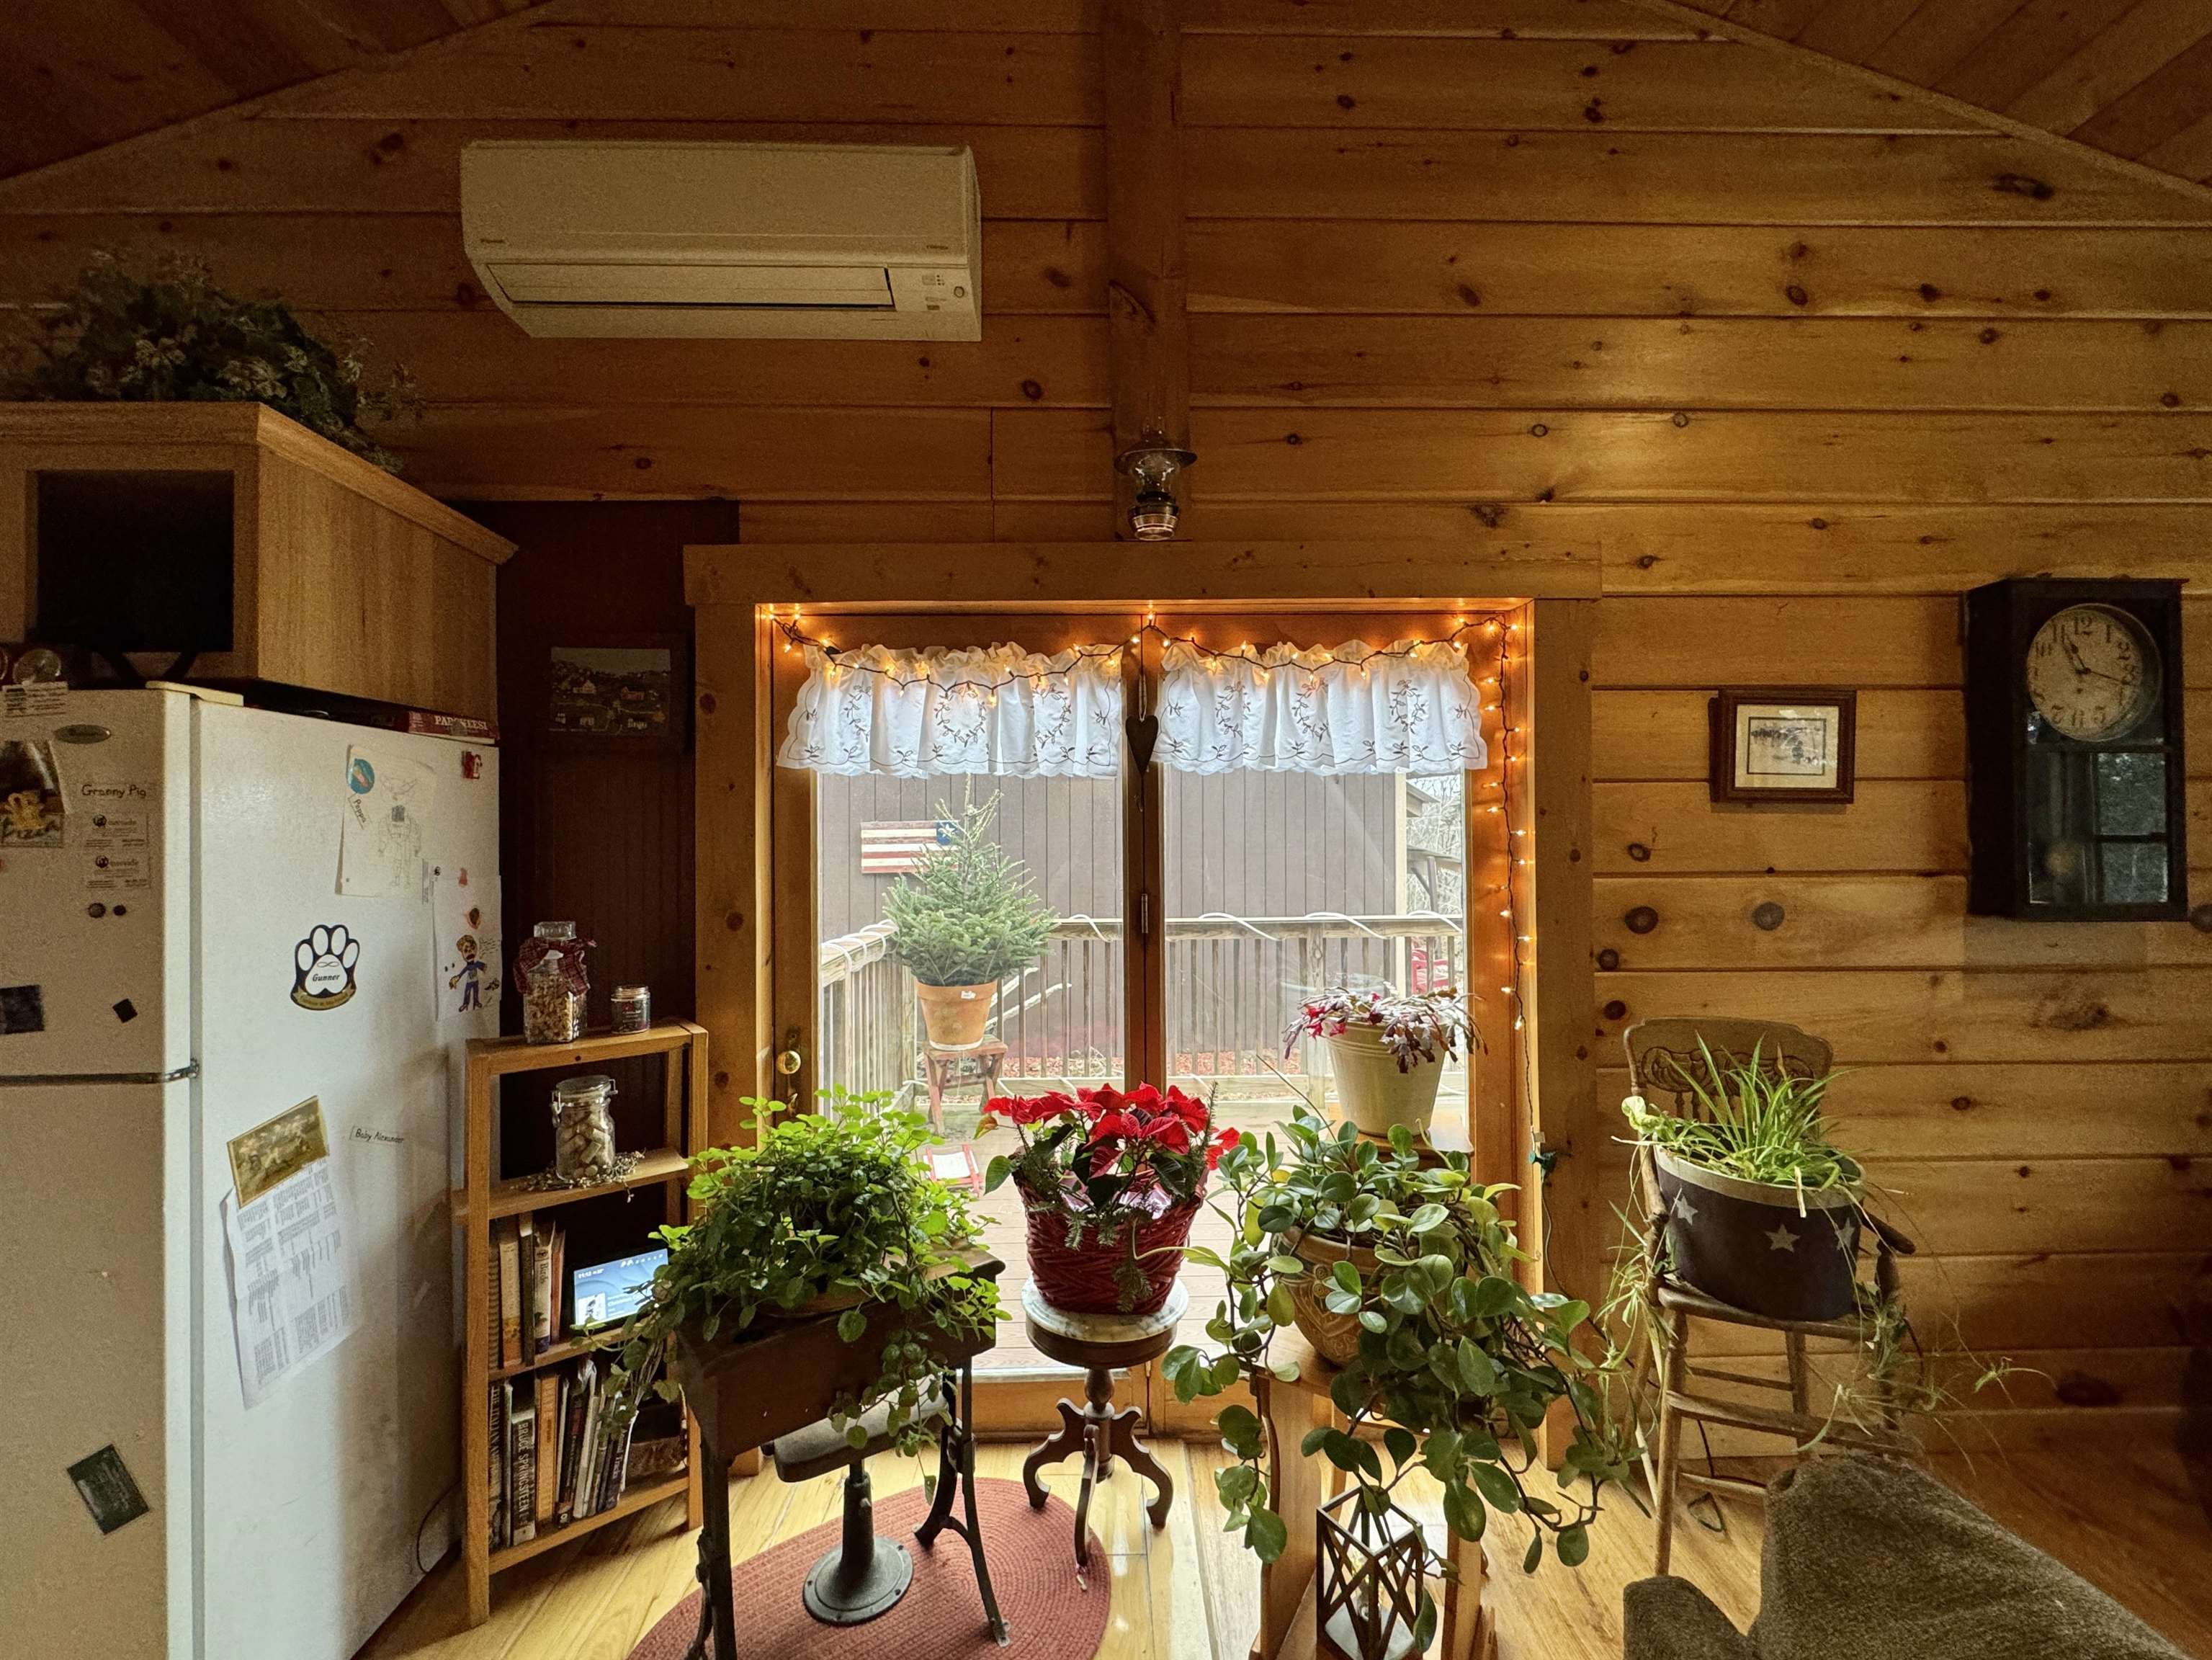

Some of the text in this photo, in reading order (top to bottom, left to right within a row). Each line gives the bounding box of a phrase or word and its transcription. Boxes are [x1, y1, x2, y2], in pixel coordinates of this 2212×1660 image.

[434, 715, 488, 731] PAREESI
[81, 784, 147, 798] Granny Pig
[312, 973, 341, 982] Gunner
[518, 1422, 529, 1452] BRUCE
[612, 1455, 623, 1479] Tracks
[518, 1453, 529, 1513] SPRINGSTEEN
